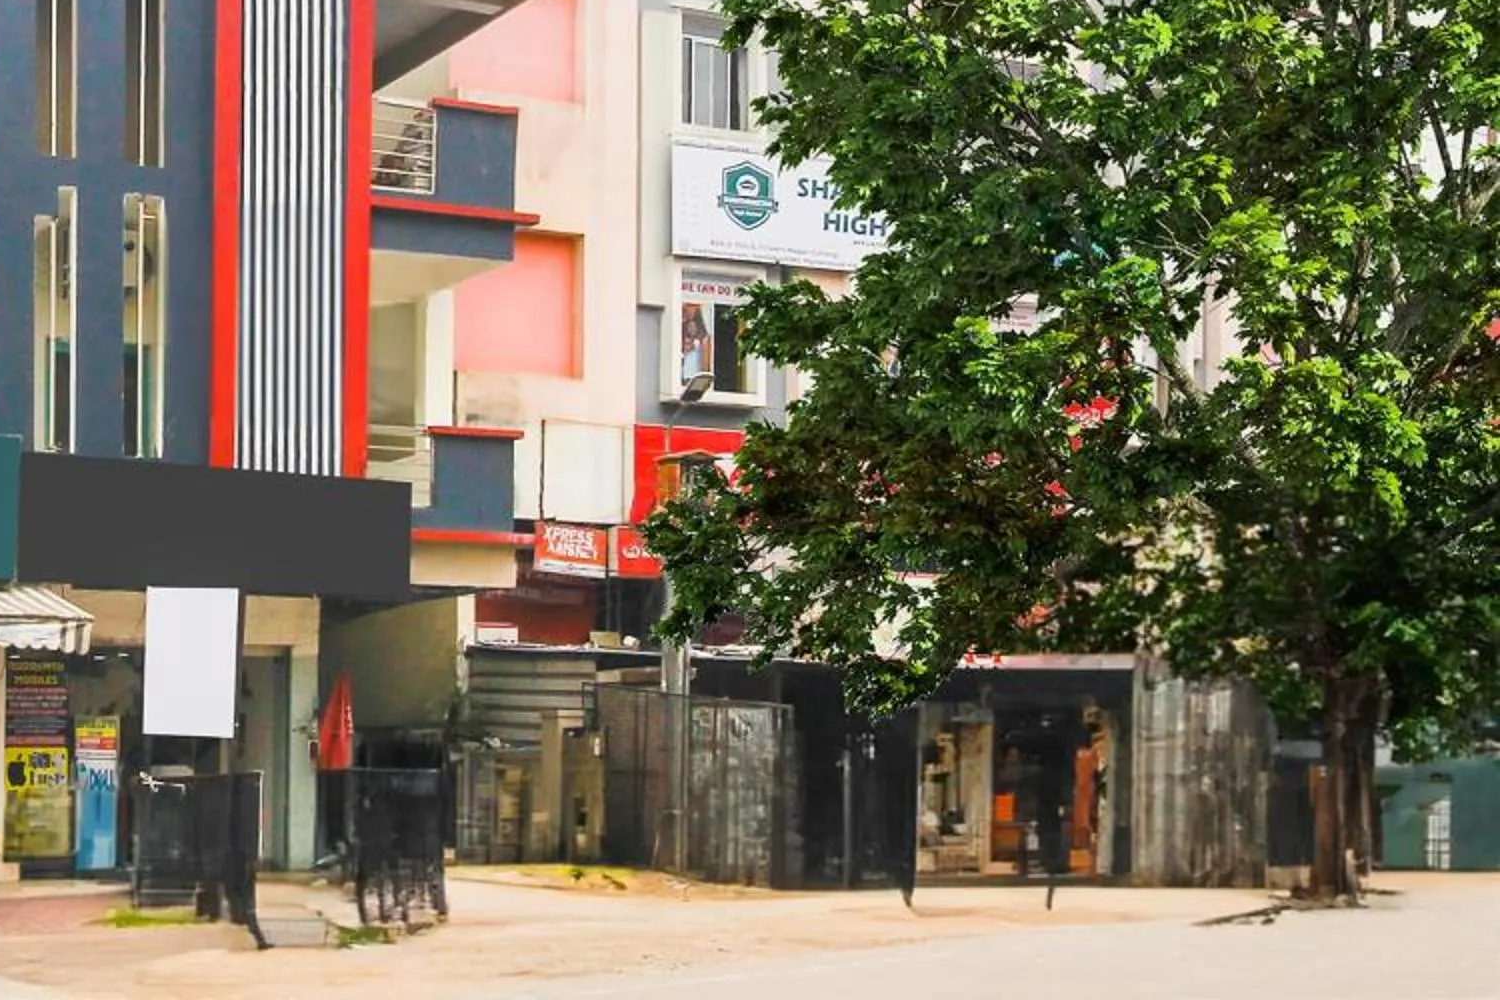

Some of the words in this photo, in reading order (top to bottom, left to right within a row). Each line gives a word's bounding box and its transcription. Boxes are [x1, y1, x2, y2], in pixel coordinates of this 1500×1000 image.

[797, 178, 845, 200] SHA
[823, 213, 887, 237] HIGH
[718, 286, 731, 297] DO
